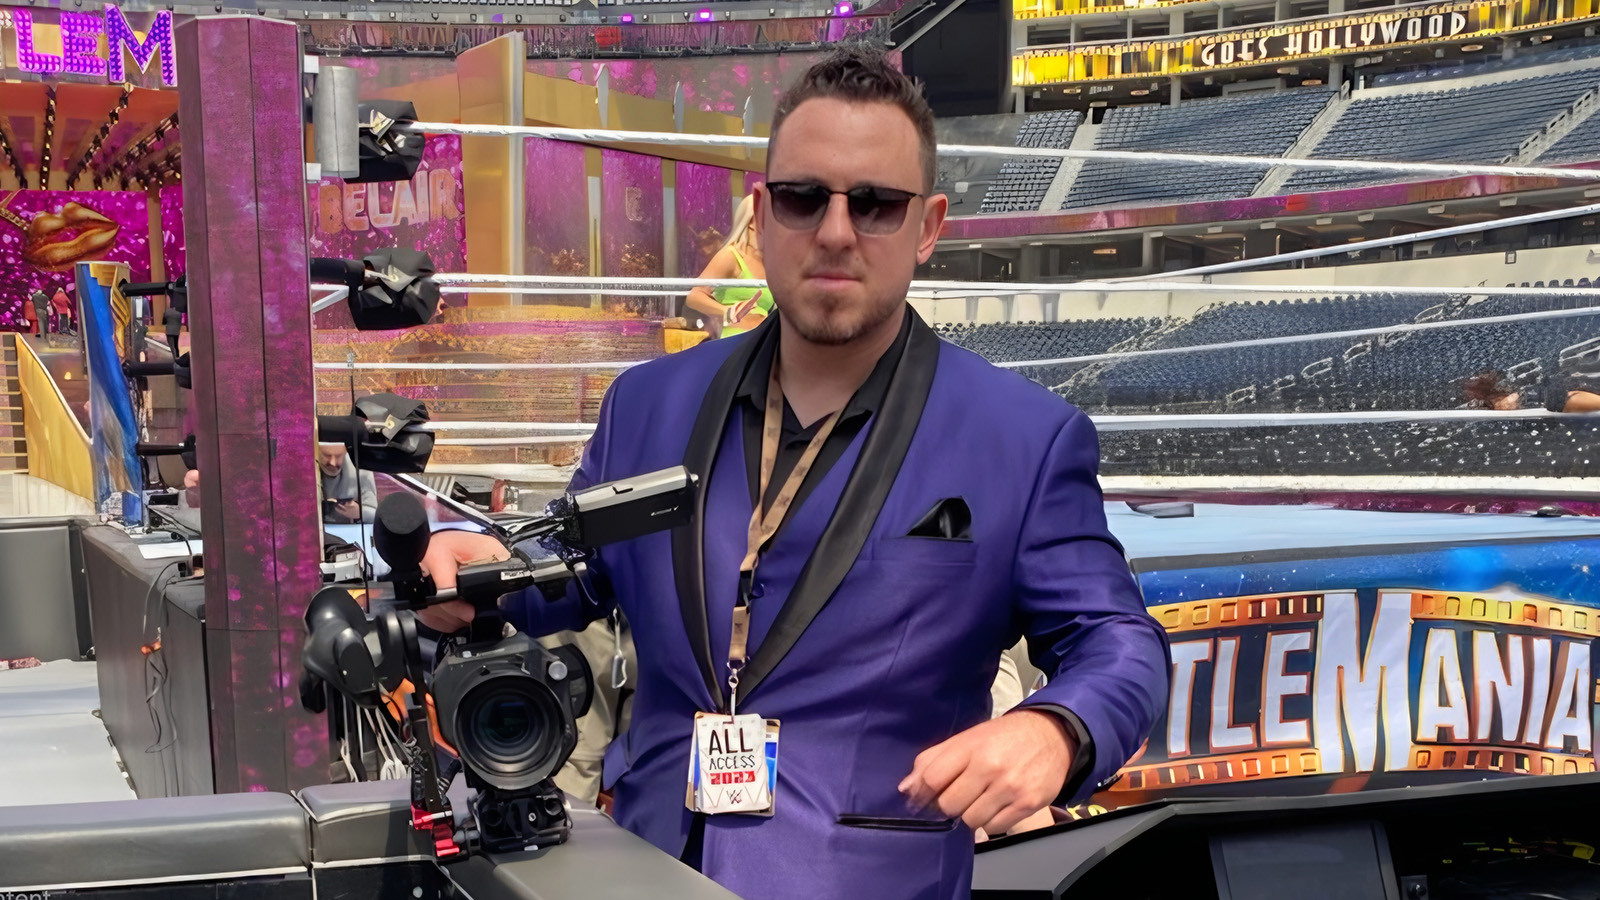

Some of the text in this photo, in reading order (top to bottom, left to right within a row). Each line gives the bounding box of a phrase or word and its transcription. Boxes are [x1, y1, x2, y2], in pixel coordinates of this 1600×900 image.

[0, 3, 177, 87] LEM
[1201, 12, 1466, 66] GOES HOLLYWOOD
[320, 168, 462, 234] BELAIR
[1168, 589, 1591, 773] TLEMANIA
[709, 728, 753, 755] ALL
[709, 755, 756, 770] ACCESS
